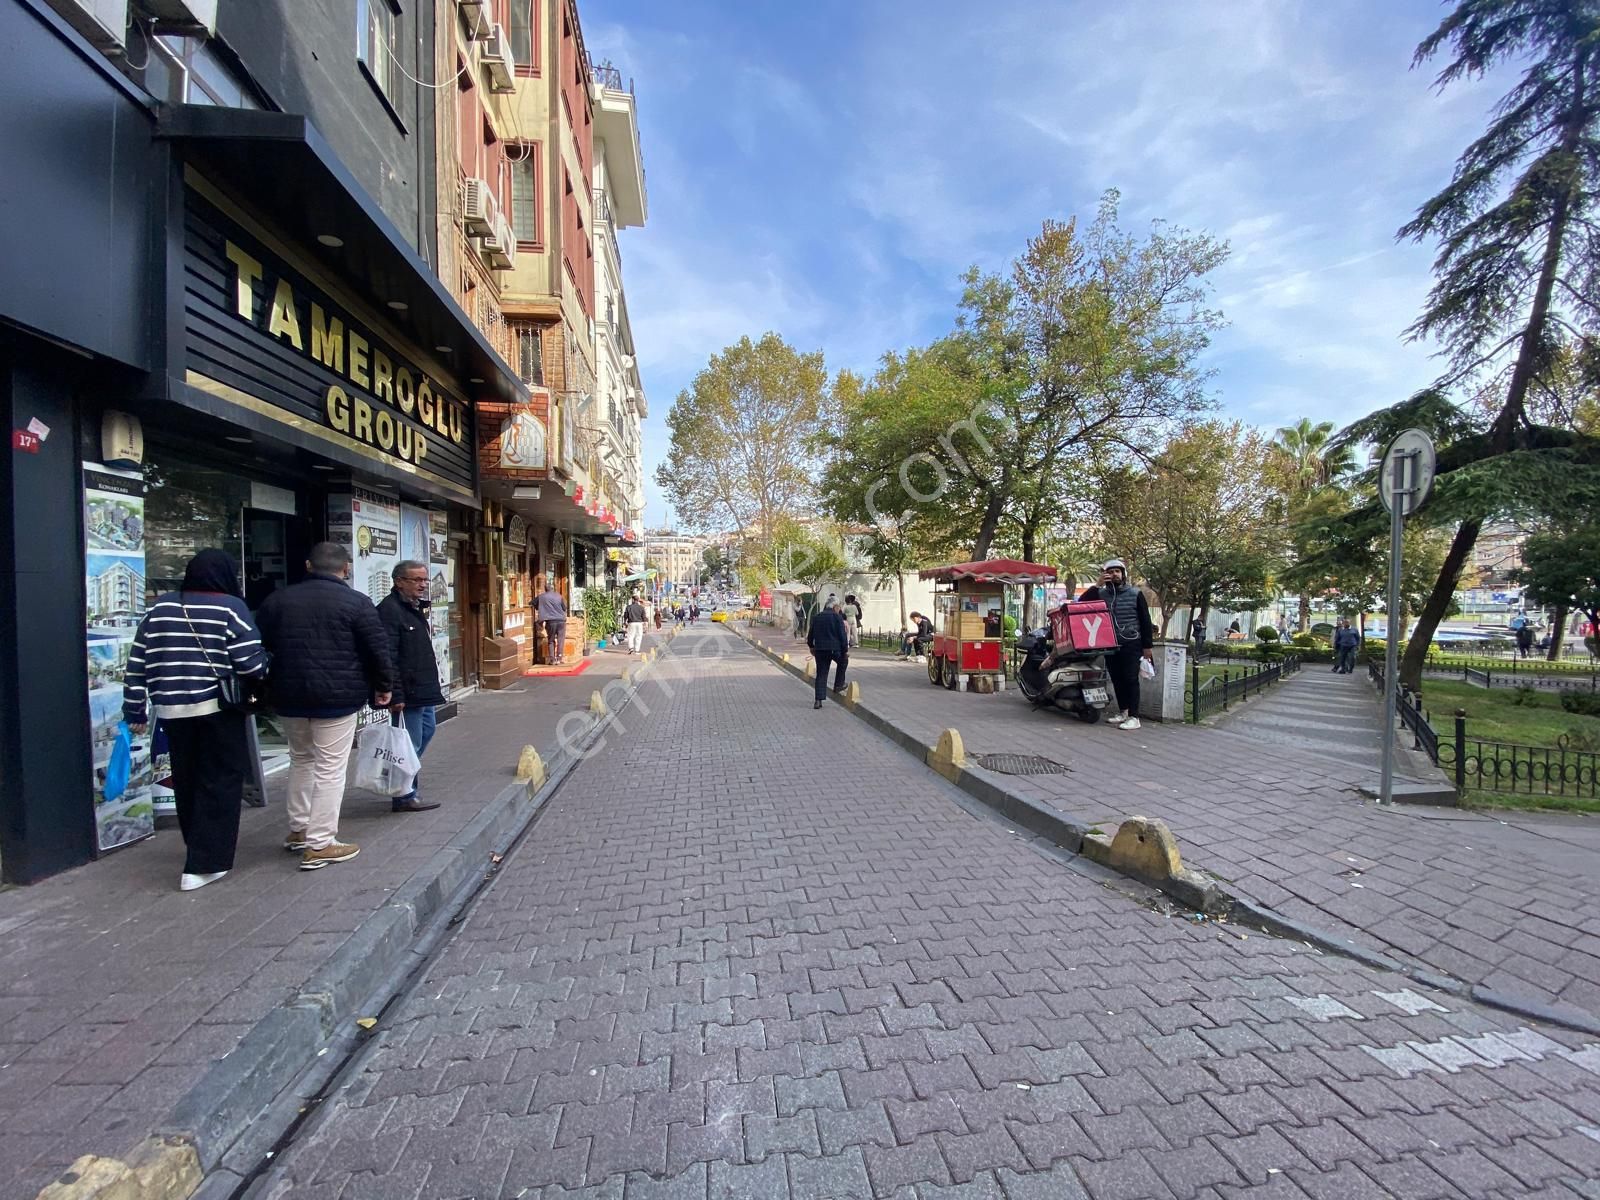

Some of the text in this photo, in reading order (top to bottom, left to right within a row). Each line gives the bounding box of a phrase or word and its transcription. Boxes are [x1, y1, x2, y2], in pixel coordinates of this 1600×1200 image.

[226, 239, 463, 444] TAMEROĞLU
[326, 384, 430, 466] GROUP
[1081, 615, 1103, 648] Y
